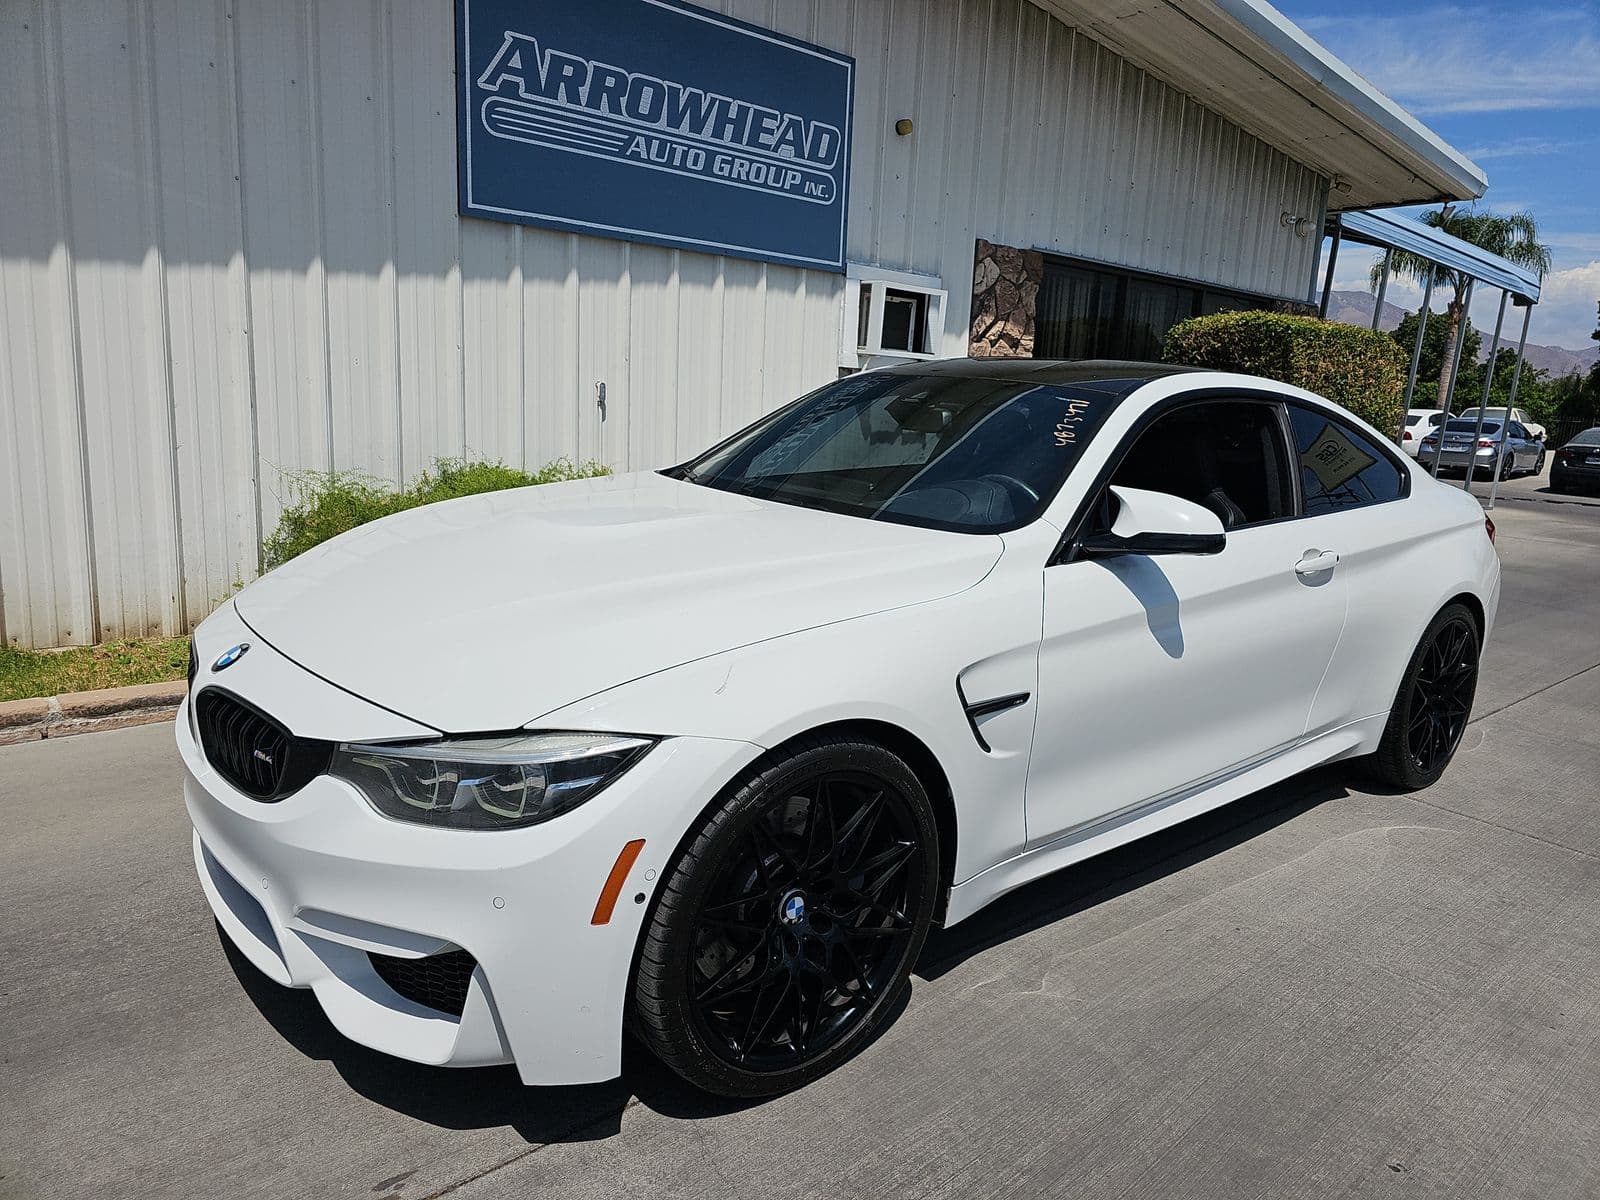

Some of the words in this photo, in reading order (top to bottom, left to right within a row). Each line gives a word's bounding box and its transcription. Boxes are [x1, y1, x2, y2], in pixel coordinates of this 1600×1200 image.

[477, 31, 842, 170] ARROWHEAD
[625, 135, 706, 171] AUTO
[713, 154, 802, 191] GROUP
[804, 181, 829, 198] INC.
